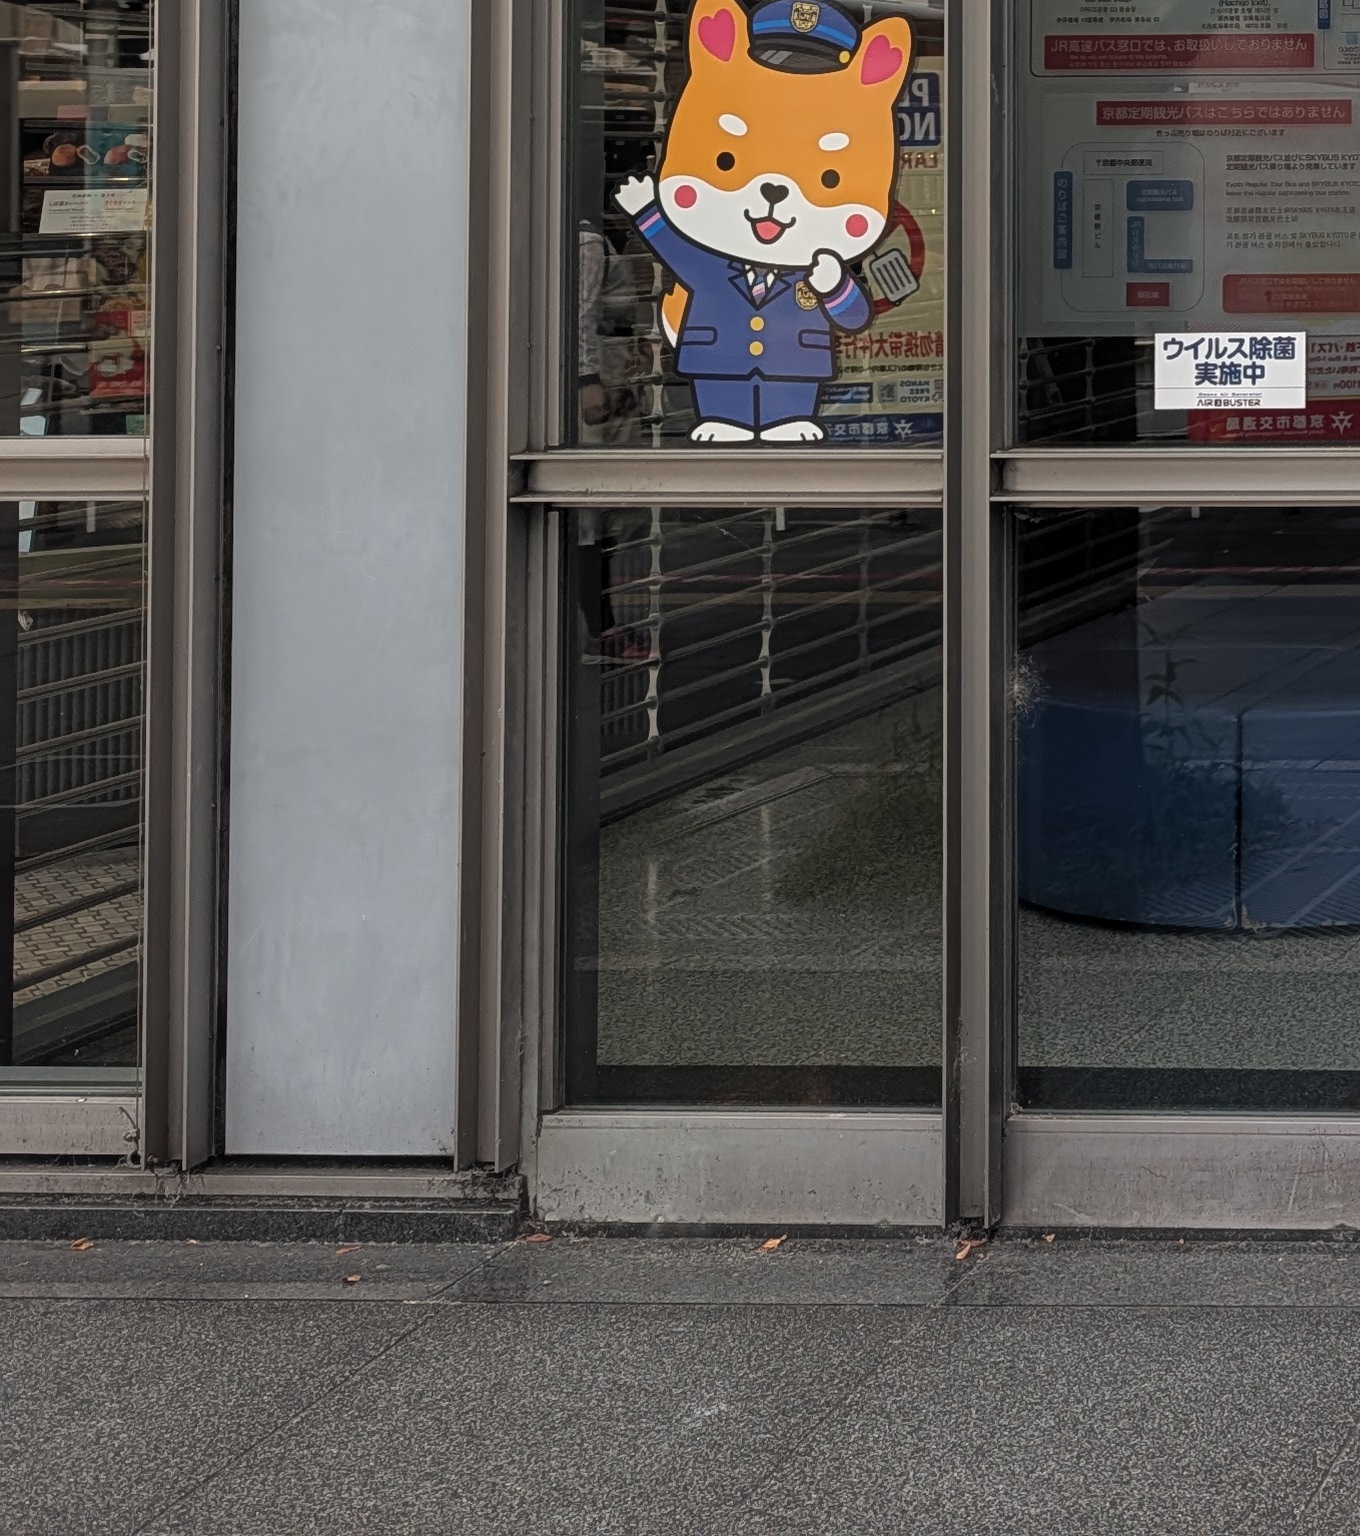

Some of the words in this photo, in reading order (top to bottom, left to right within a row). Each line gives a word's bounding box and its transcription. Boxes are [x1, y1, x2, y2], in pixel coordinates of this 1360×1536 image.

[1102, 105, 1346, 120] 京都定期観光バスはこちらではありません
[1162, 336, 1297, 361] ウイルス除菌
[1193, 360, 1266, 386] 実施中
[1223, 398, 1262, 407] BUSTER
